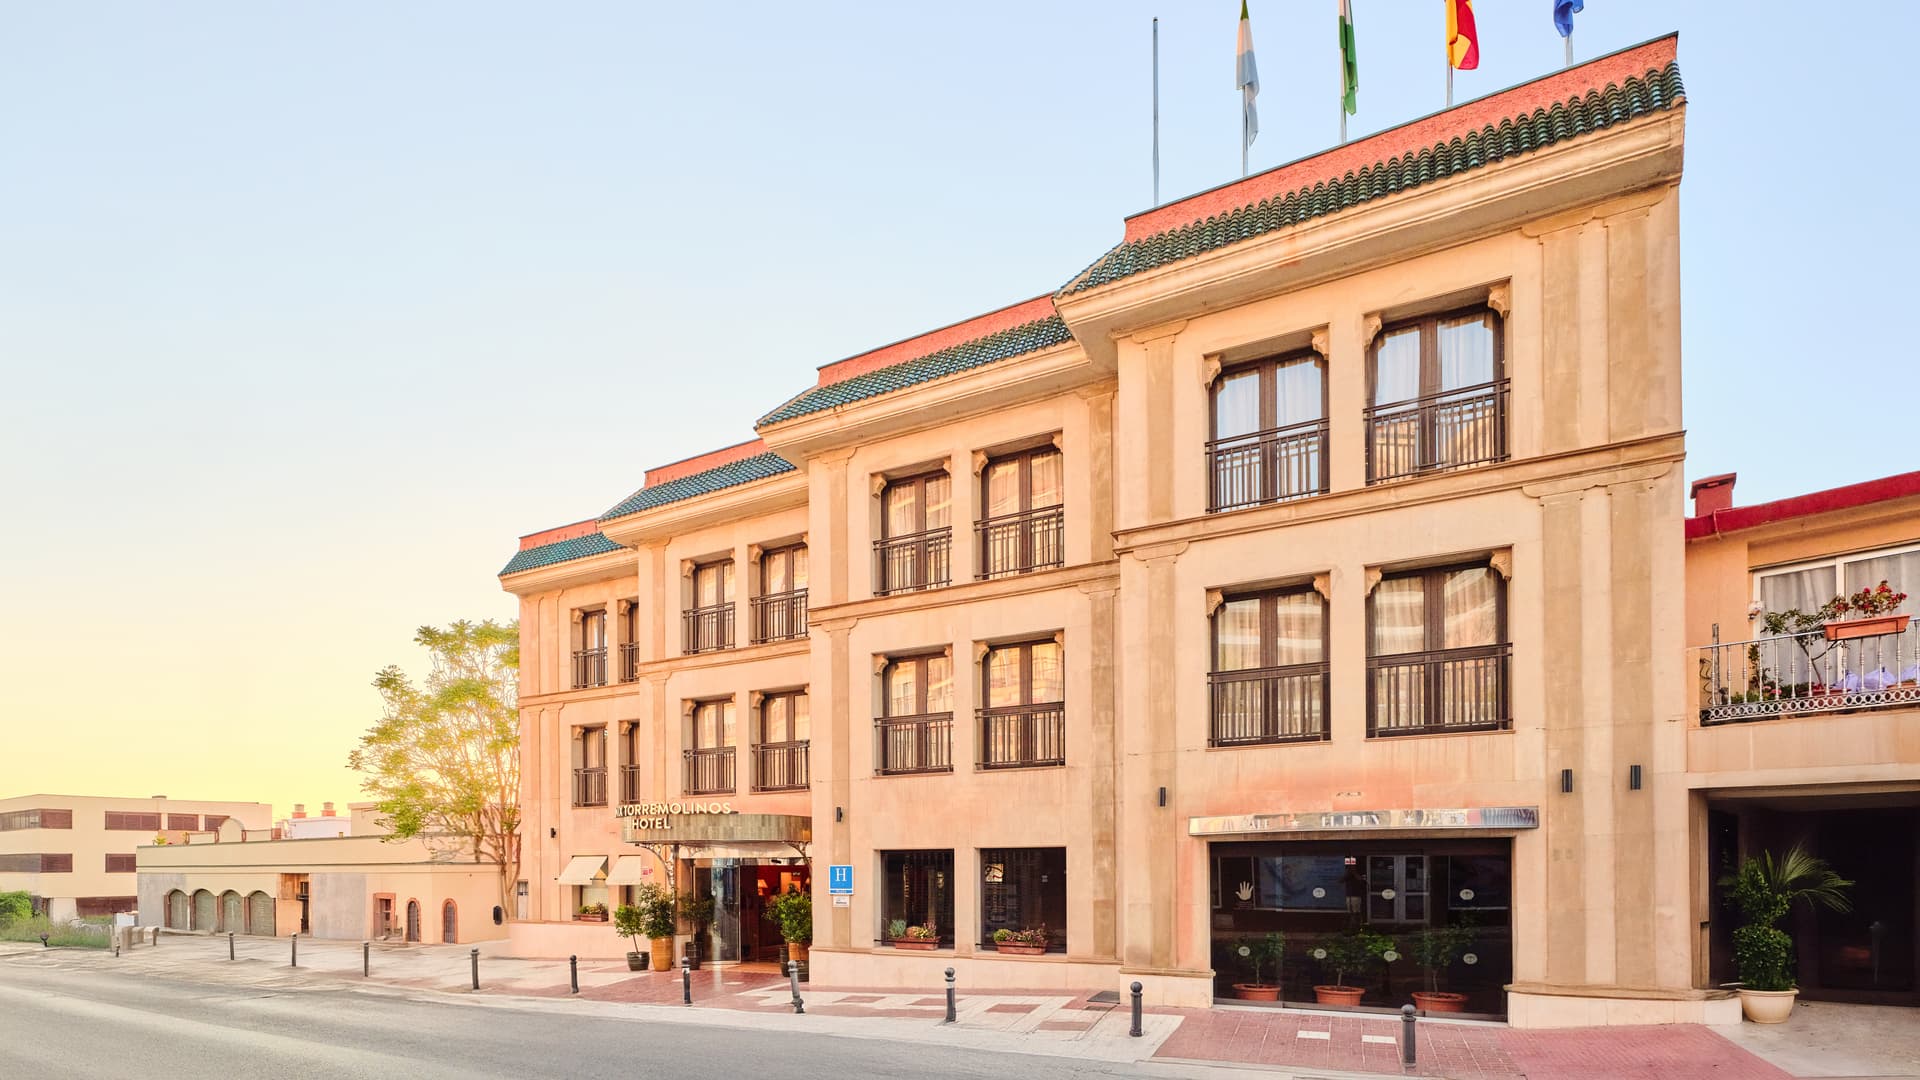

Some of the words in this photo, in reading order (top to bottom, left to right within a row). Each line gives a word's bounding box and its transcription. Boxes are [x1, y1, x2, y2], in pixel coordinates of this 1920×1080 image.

[623, 802, 731, 817] TORREMOLINOS
[633, 817, 671, 829] HOTEL
[835, 868, 847, 882] H
